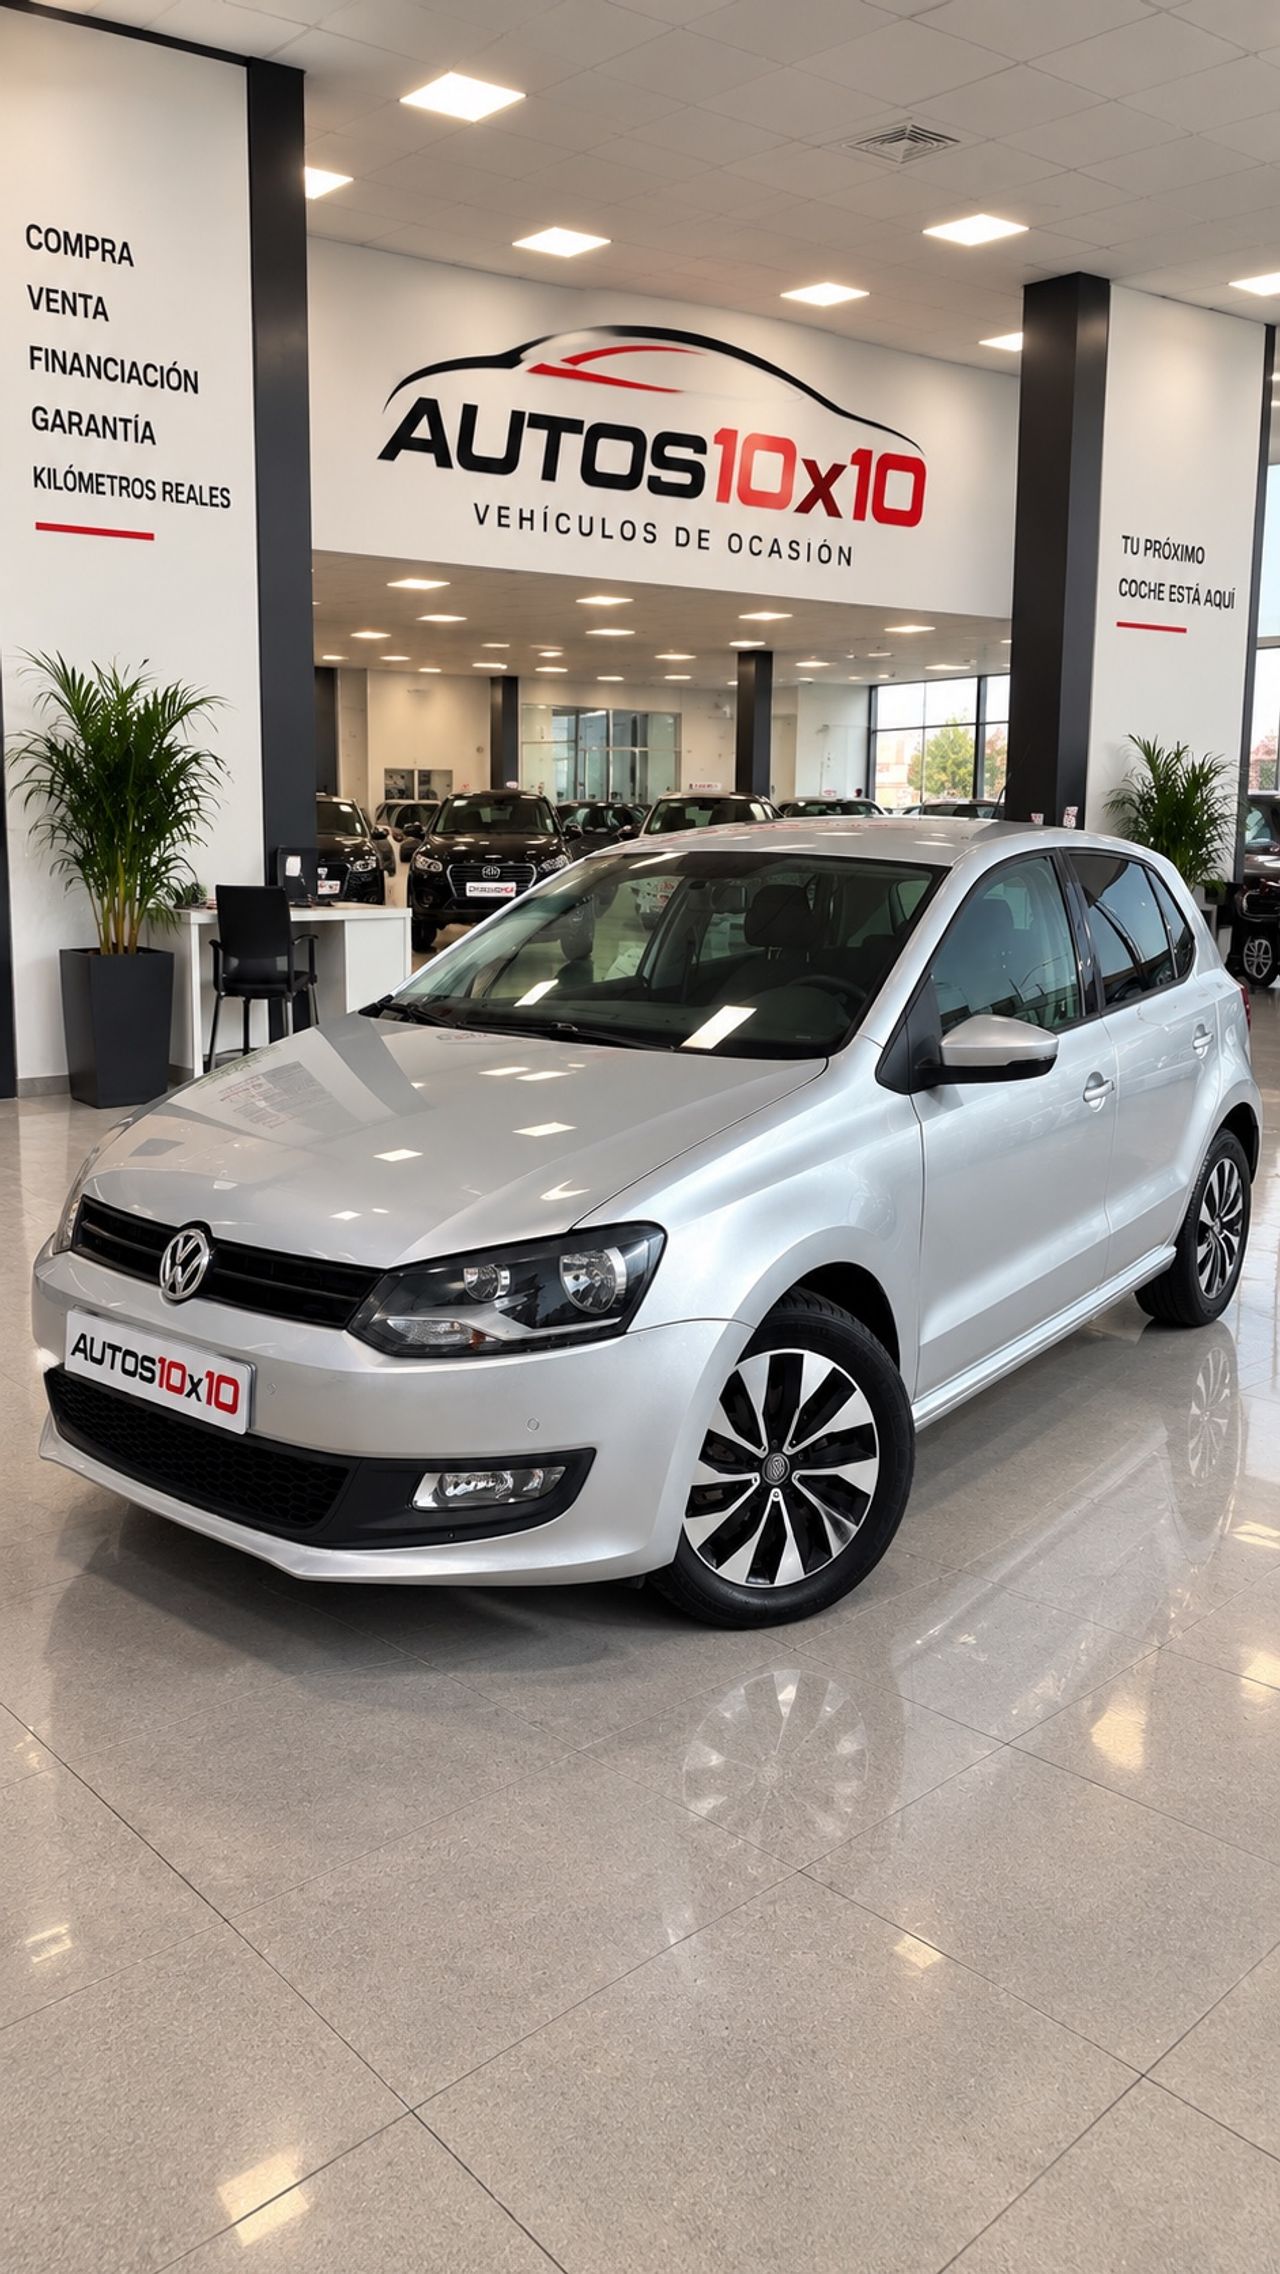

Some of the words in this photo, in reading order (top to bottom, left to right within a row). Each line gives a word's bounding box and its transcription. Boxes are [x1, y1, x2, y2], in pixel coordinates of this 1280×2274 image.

[25, 223, 135, 268] COMPRA
[26, 284, 110, 322] VENTA
[29, 345, 200, 395] FINANCIACIÓN
[31, 405, 157, 446] GARANTÍA
[33, 464, 157, 501] KILÓMETROS
[161, 481, 231, 509] REALES
[473, 502, 658, 545] VEHÍCULOS
[675, 526, 711, 551] DE
[727, 532, 853, 567] OCASIÓN
[1121, 534, 1140, 556] TU
[1144, 536, 1205, 565] PRÓXIMO
[1118, 577, 1165, 601] COCHE
[1168, 583, 1201, 606] ESTÁ
[1203, 587, 1236, 610] AQUÍ
[70, 1332, 240, 1416] AUTOS10x10
